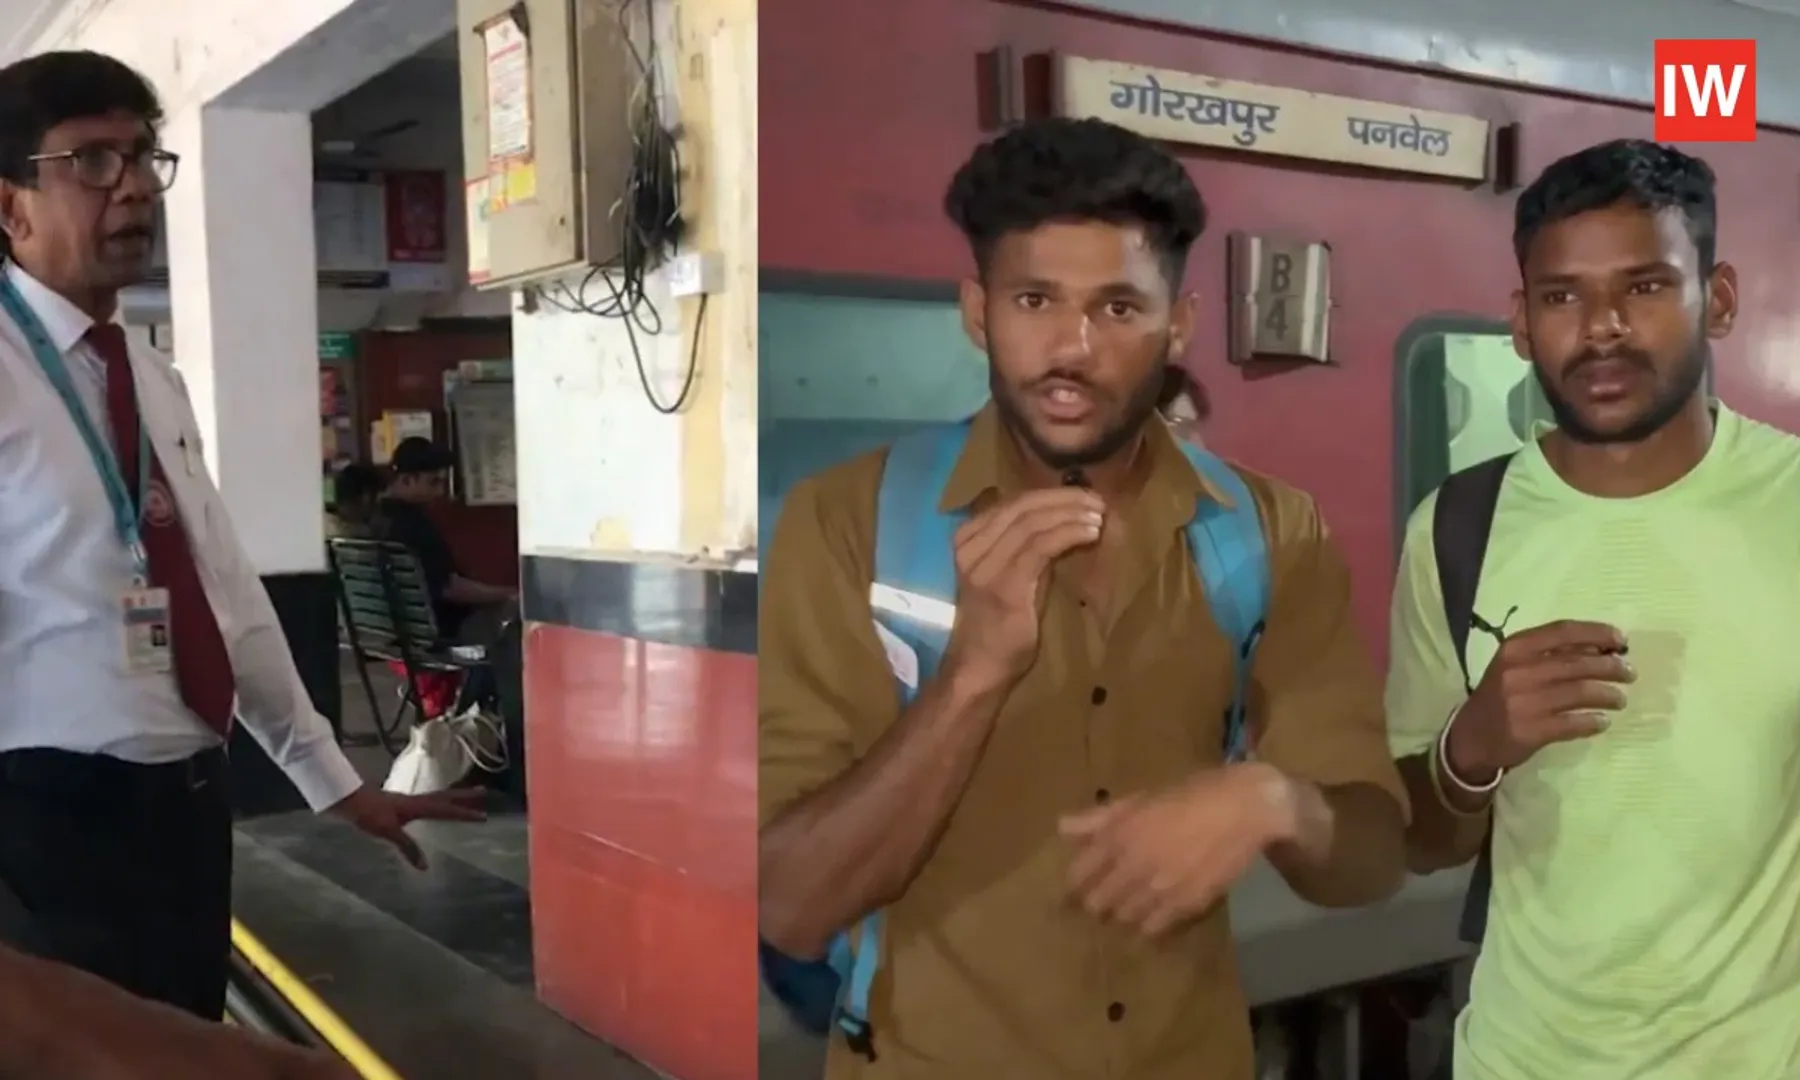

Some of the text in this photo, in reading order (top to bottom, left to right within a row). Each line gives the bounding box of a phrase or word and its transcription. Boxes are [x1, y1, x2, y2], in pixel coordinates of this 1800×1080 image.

[1110, 75, 1451, 156] गोरखपुर पनवेल
[1271, 254, 1292, 294] B
[1265, 299, 1289, 340] 4
